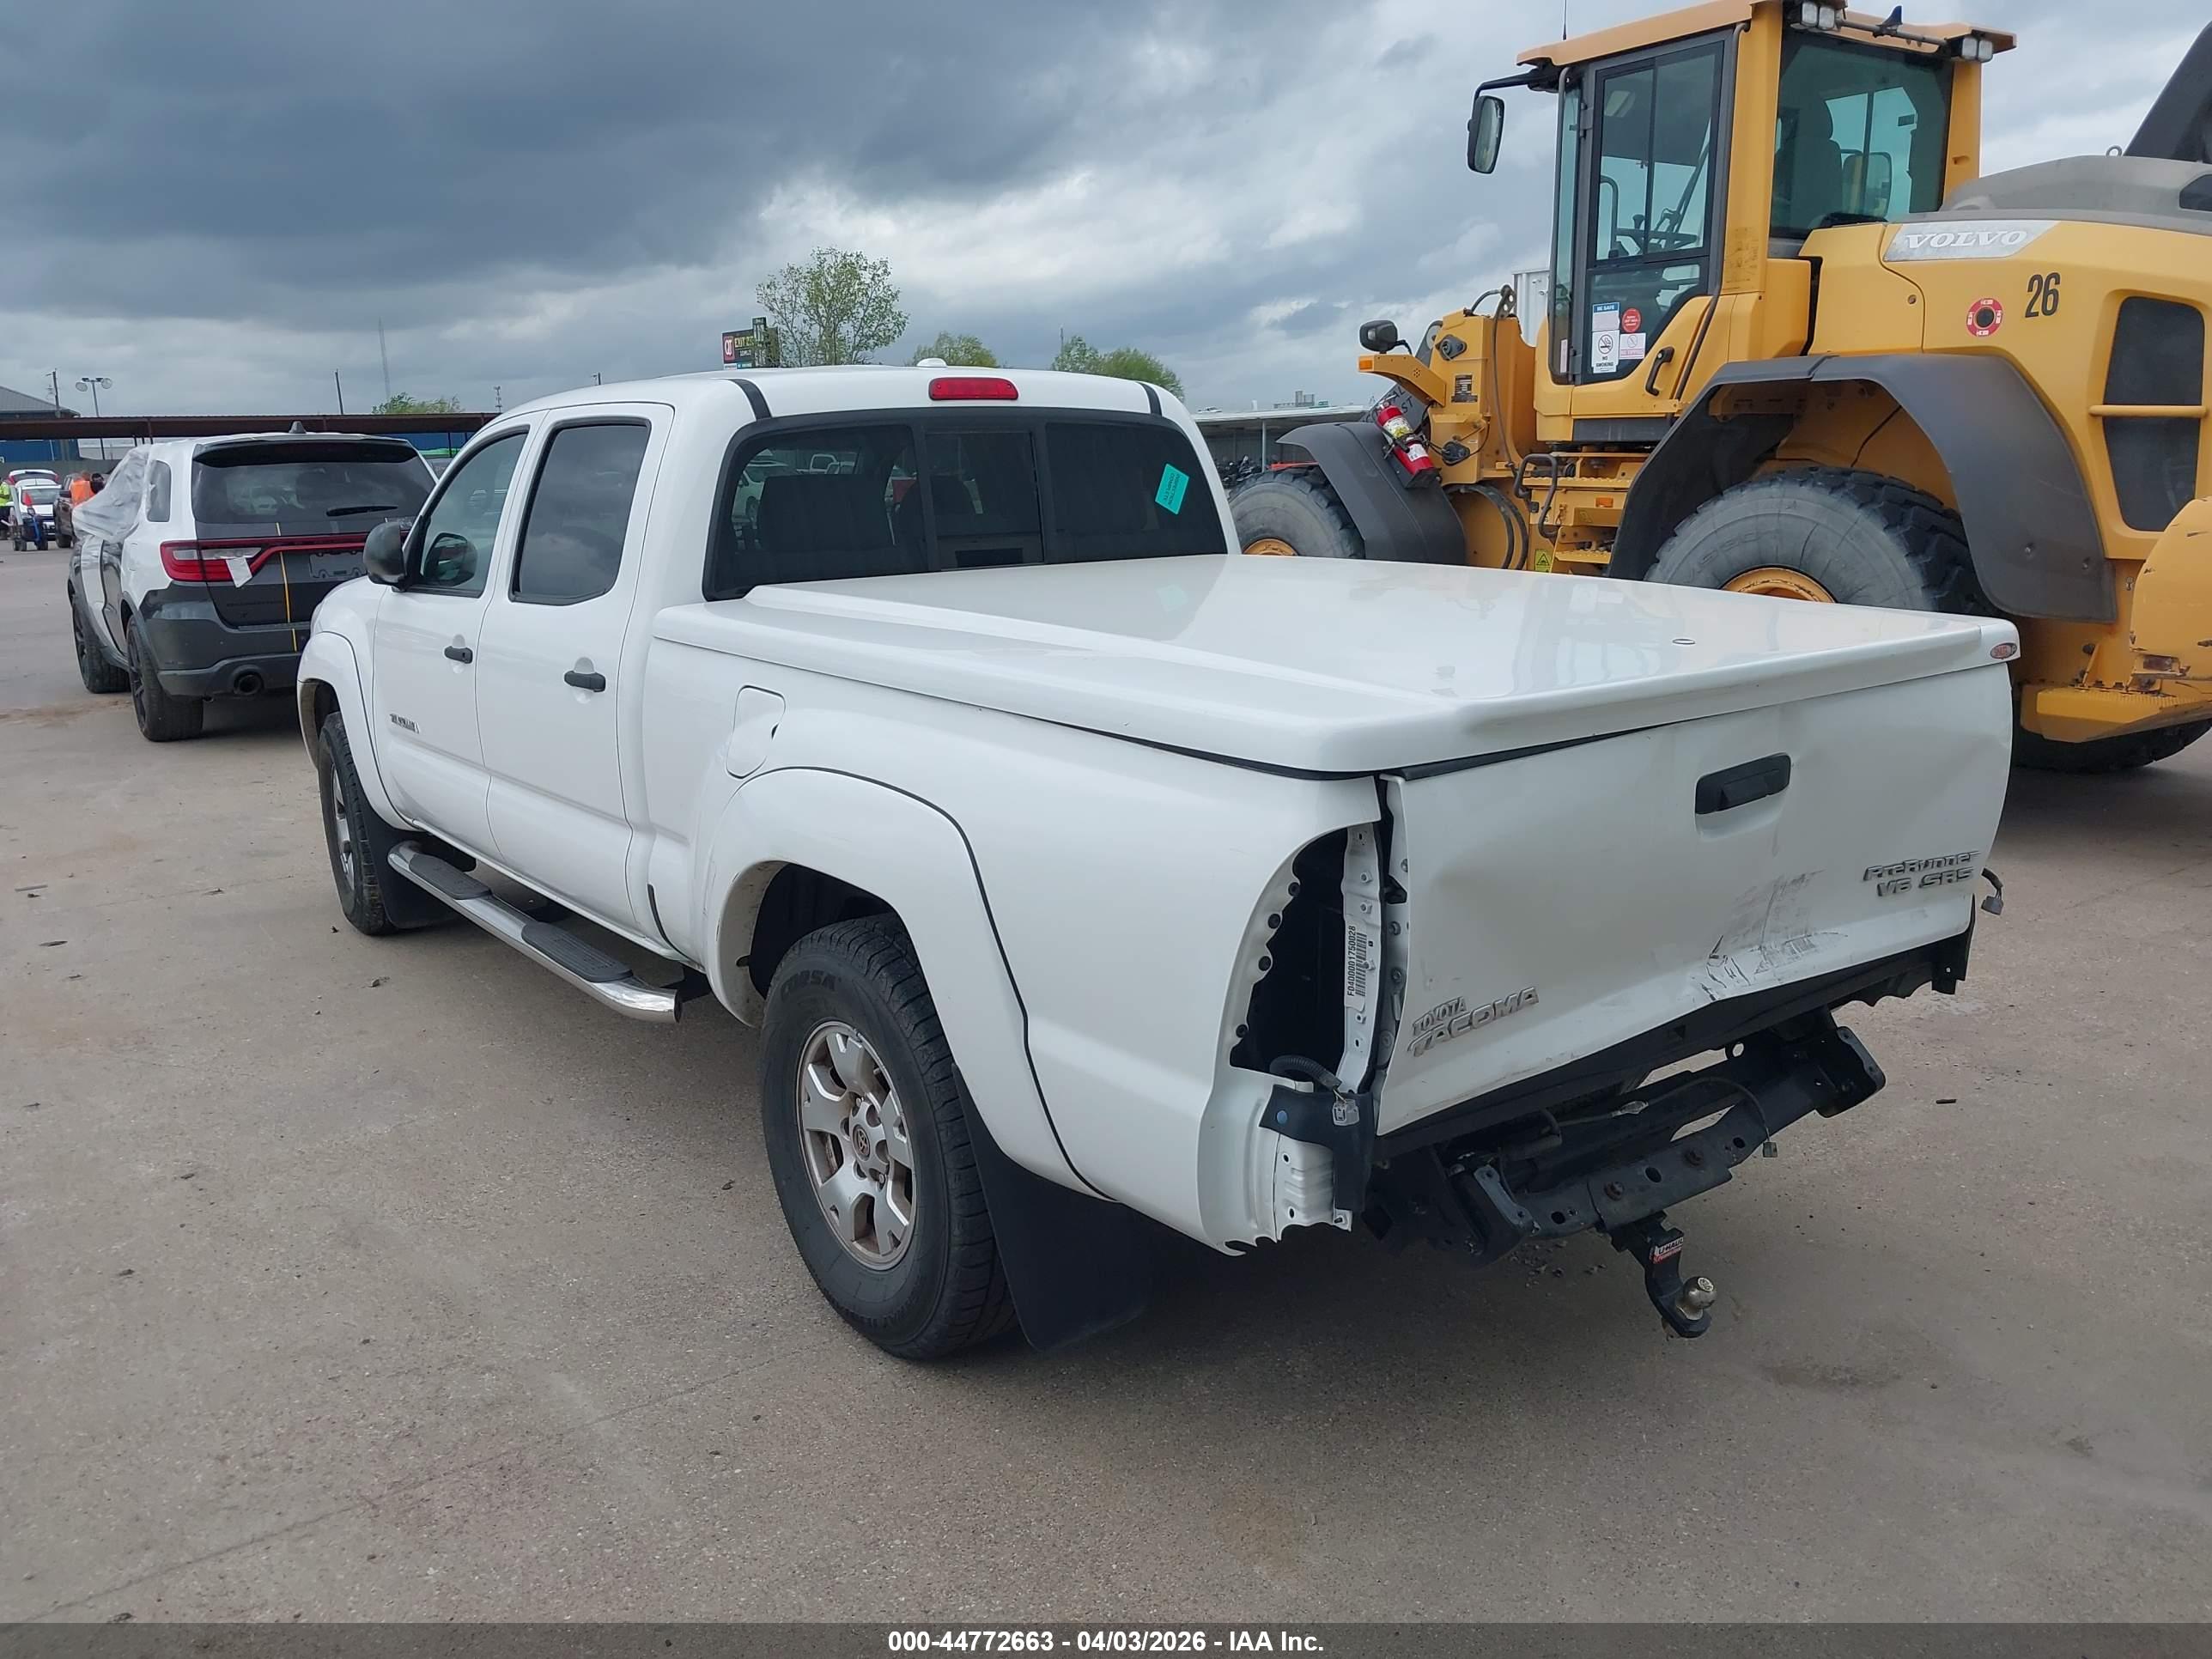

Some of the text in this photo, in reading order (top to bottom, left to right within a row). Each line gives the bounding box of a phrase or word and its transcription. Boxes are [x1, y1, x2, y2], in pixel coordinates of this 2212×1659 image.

[1905, 230, 2027, 249] VOLVO
[2025, 271, 2061, 318] 26
[1863, 850, 1981, 881] PreRunner
[1876, 866, 1974, 896] V6 SR5
[1346, 925, 1357, 997] F0400001750028
[1407, 987, 1540, 1057] TACOMA
[1412, 996, 1468, 1036] TOYOTA
